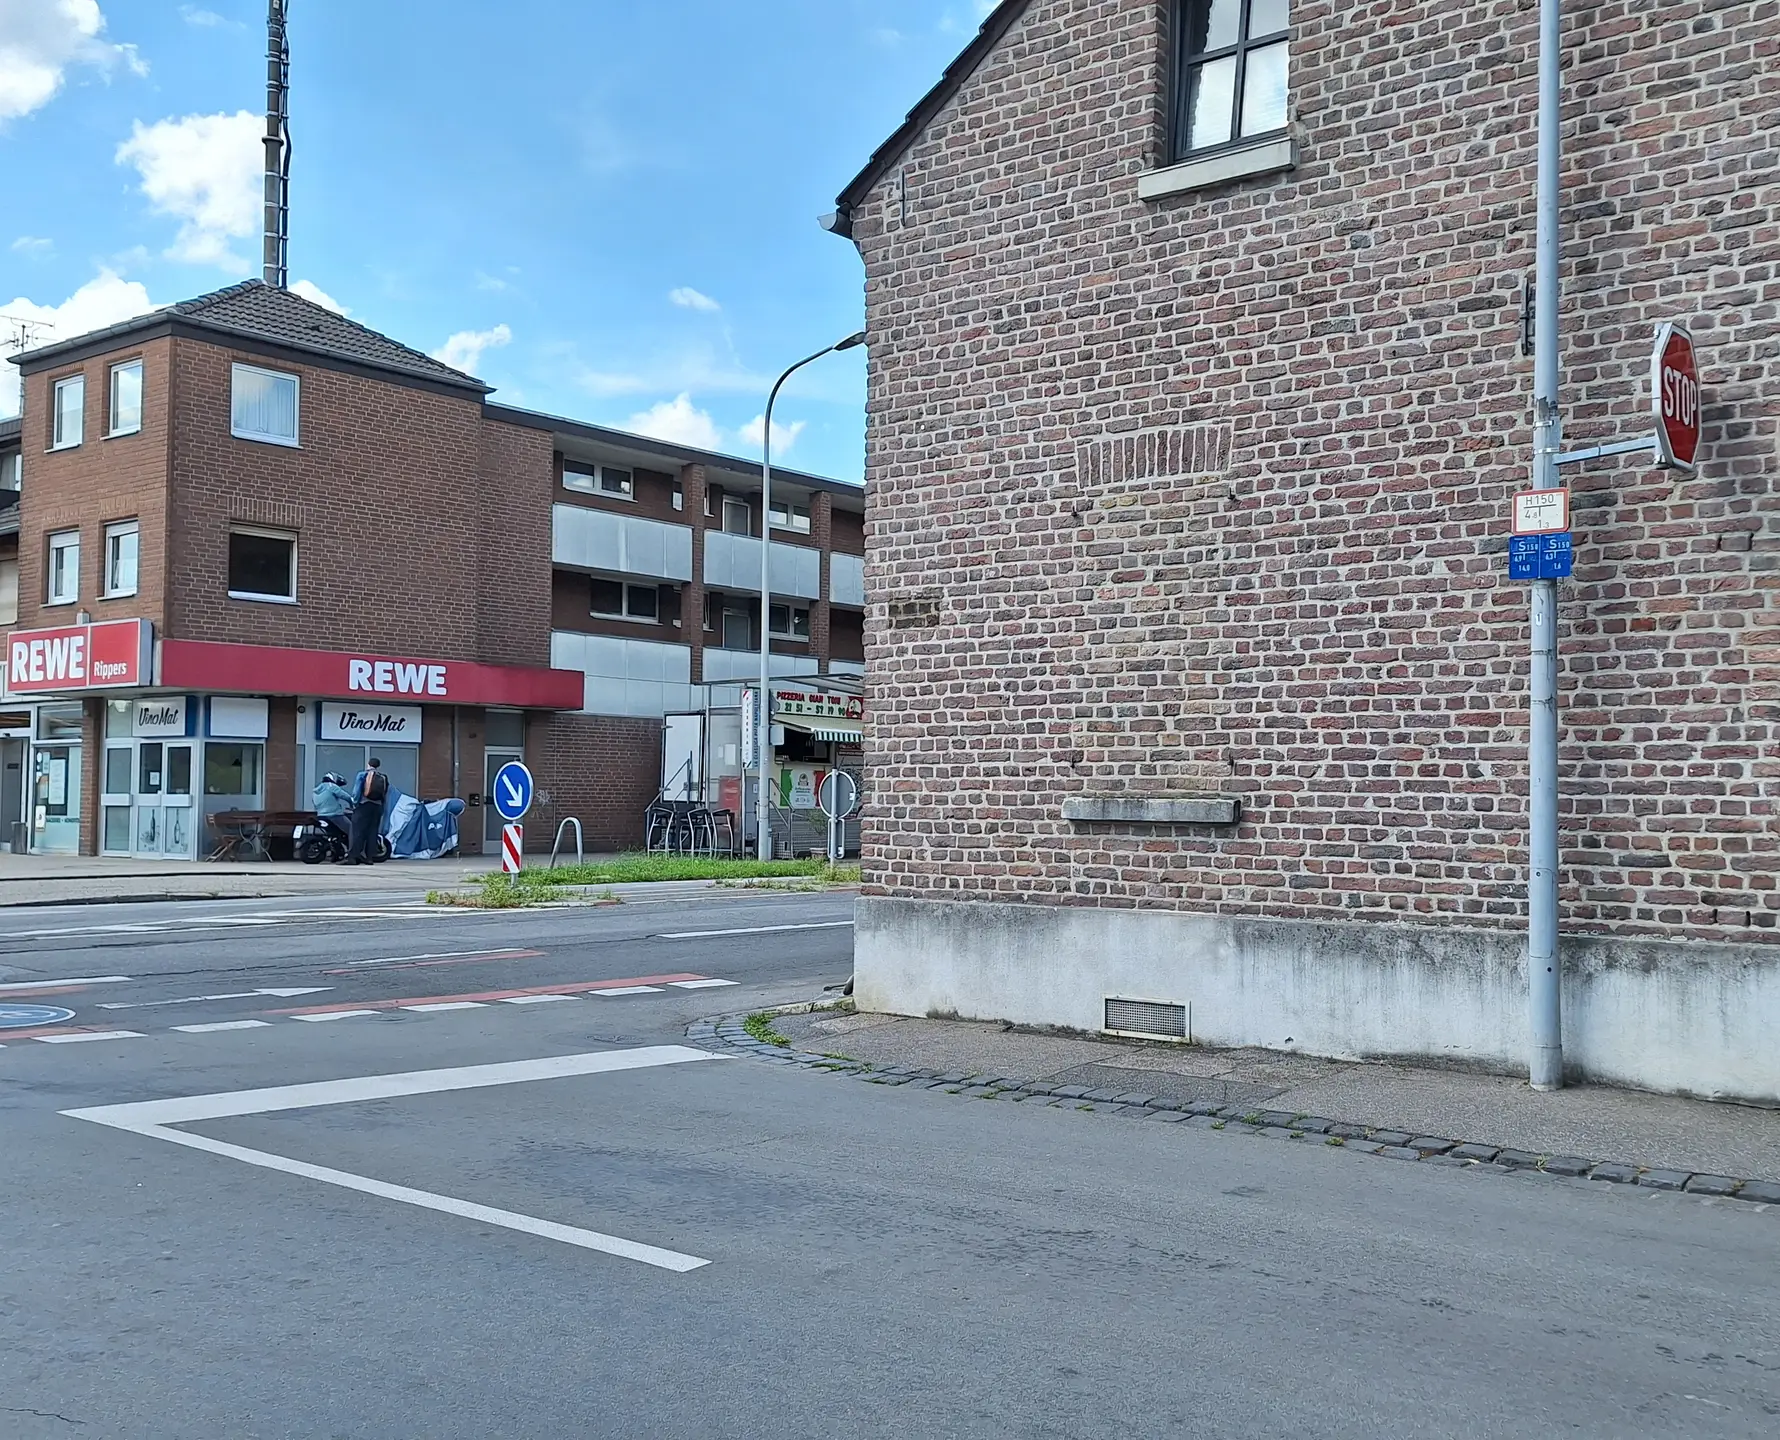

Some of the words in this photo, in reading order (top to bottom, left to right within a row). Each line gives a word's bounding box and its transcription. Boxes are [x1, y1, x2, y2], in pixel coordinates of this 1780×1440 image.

[1664, 365, 1697, 429] STOP
[1525, 493, 1555, 506] H150
[11, 635, 85, 683] REWE
[93, 660, 127, 680] Rippers
[348, 659, 448, 696] REWE
[776, 691, 805, 702] PIZZERIA
